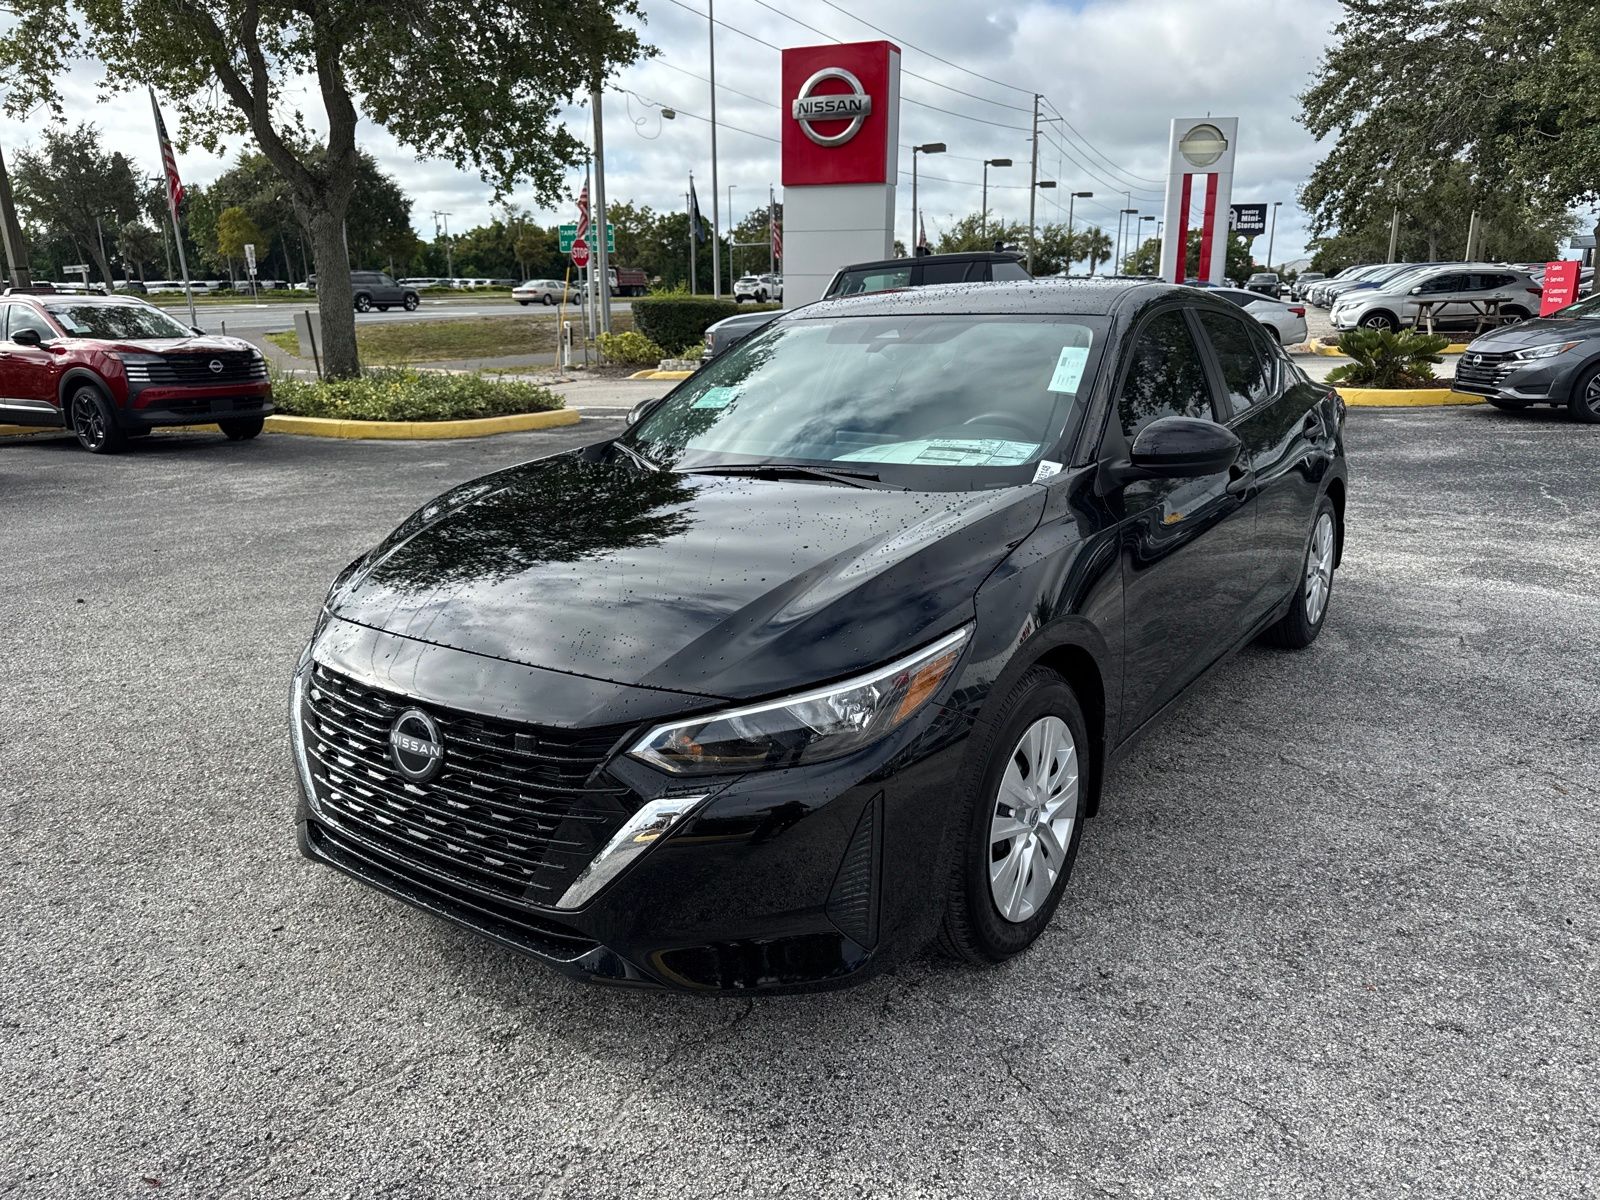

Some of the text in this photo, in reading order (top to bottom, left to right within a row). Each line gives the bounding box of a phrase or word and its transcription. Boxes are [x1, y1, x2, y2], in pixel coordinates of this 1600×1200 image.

[798, 100, 861, 115] NISSAN
[572, 247, 589, 259] STOP
[390, 732, 440, 757] NISSAN
